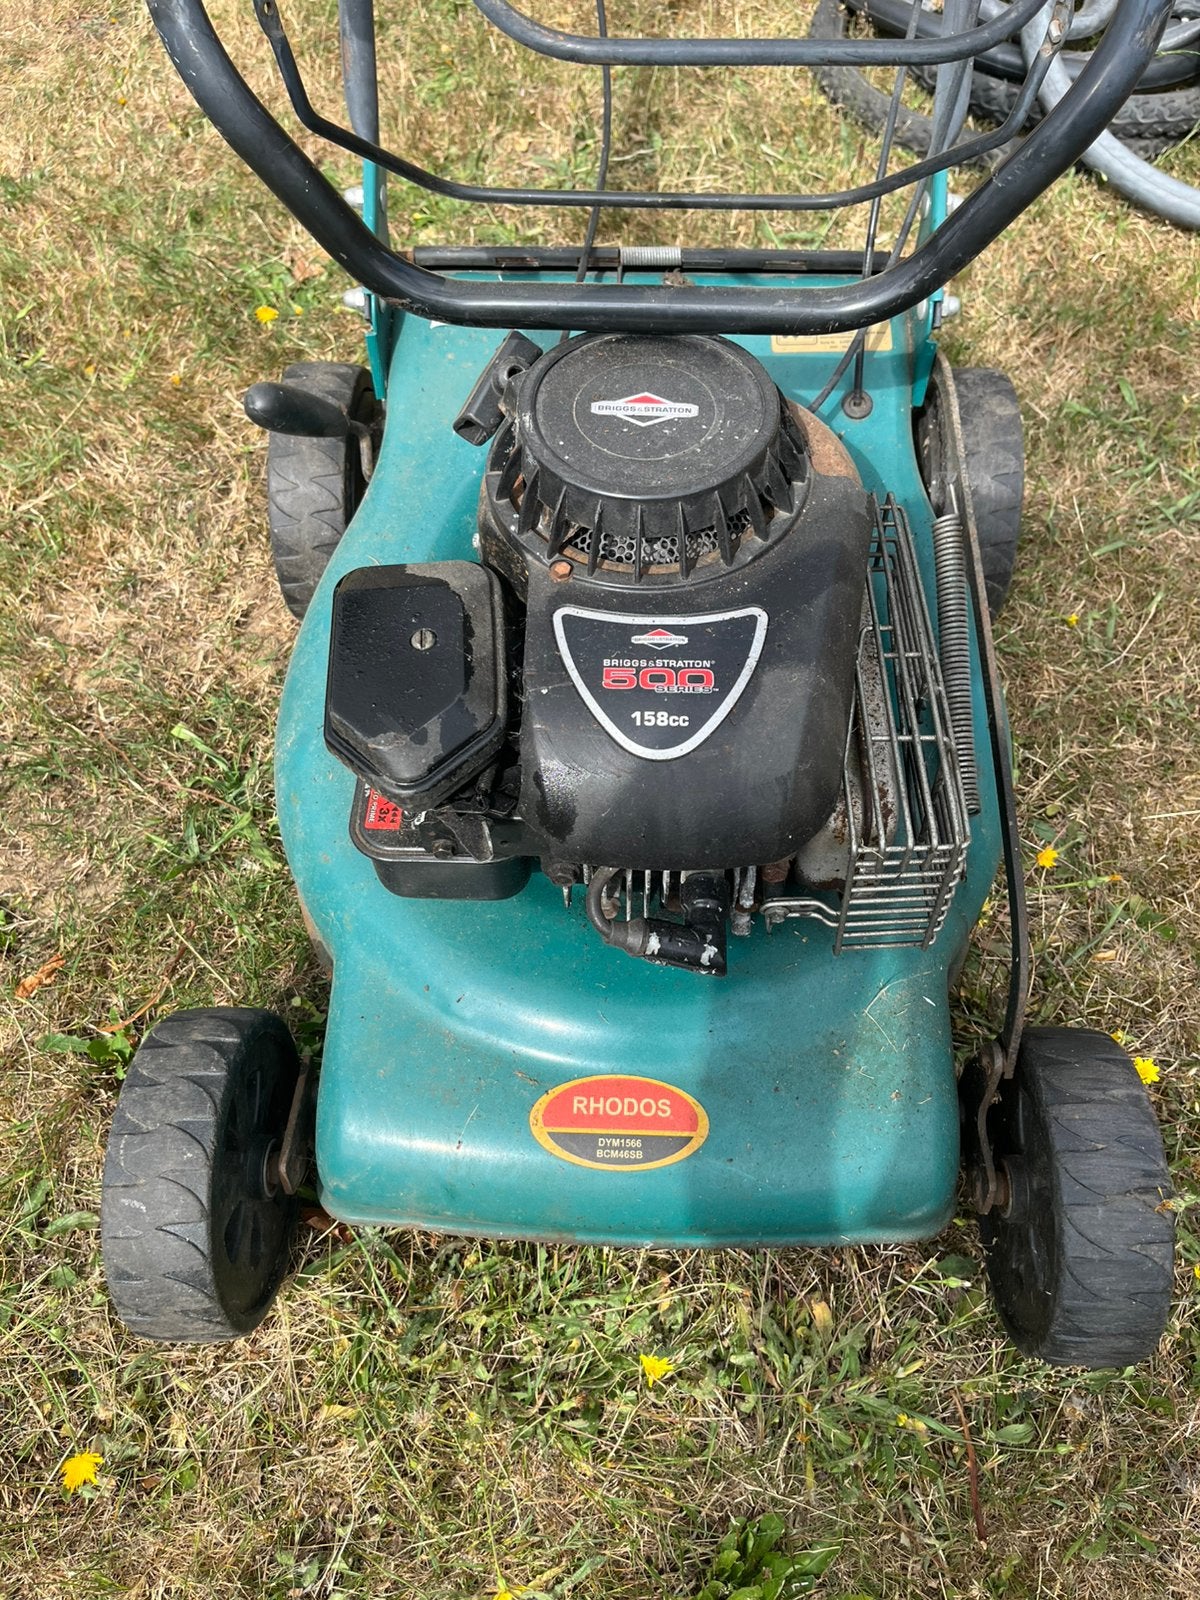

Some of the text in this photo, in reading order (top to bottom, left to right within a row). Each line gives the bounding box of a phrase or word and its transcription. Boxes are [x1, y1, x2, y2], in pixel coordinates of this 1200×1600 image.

[602, 667, 715, 690] 500
[630, 711, 690, 727] 158cc
[572, 1096, 672, 1118] RHODOS
[598, 1138, 642, 1148] DYM1566
[596, 1150, 644, 1160] BCM46SB
